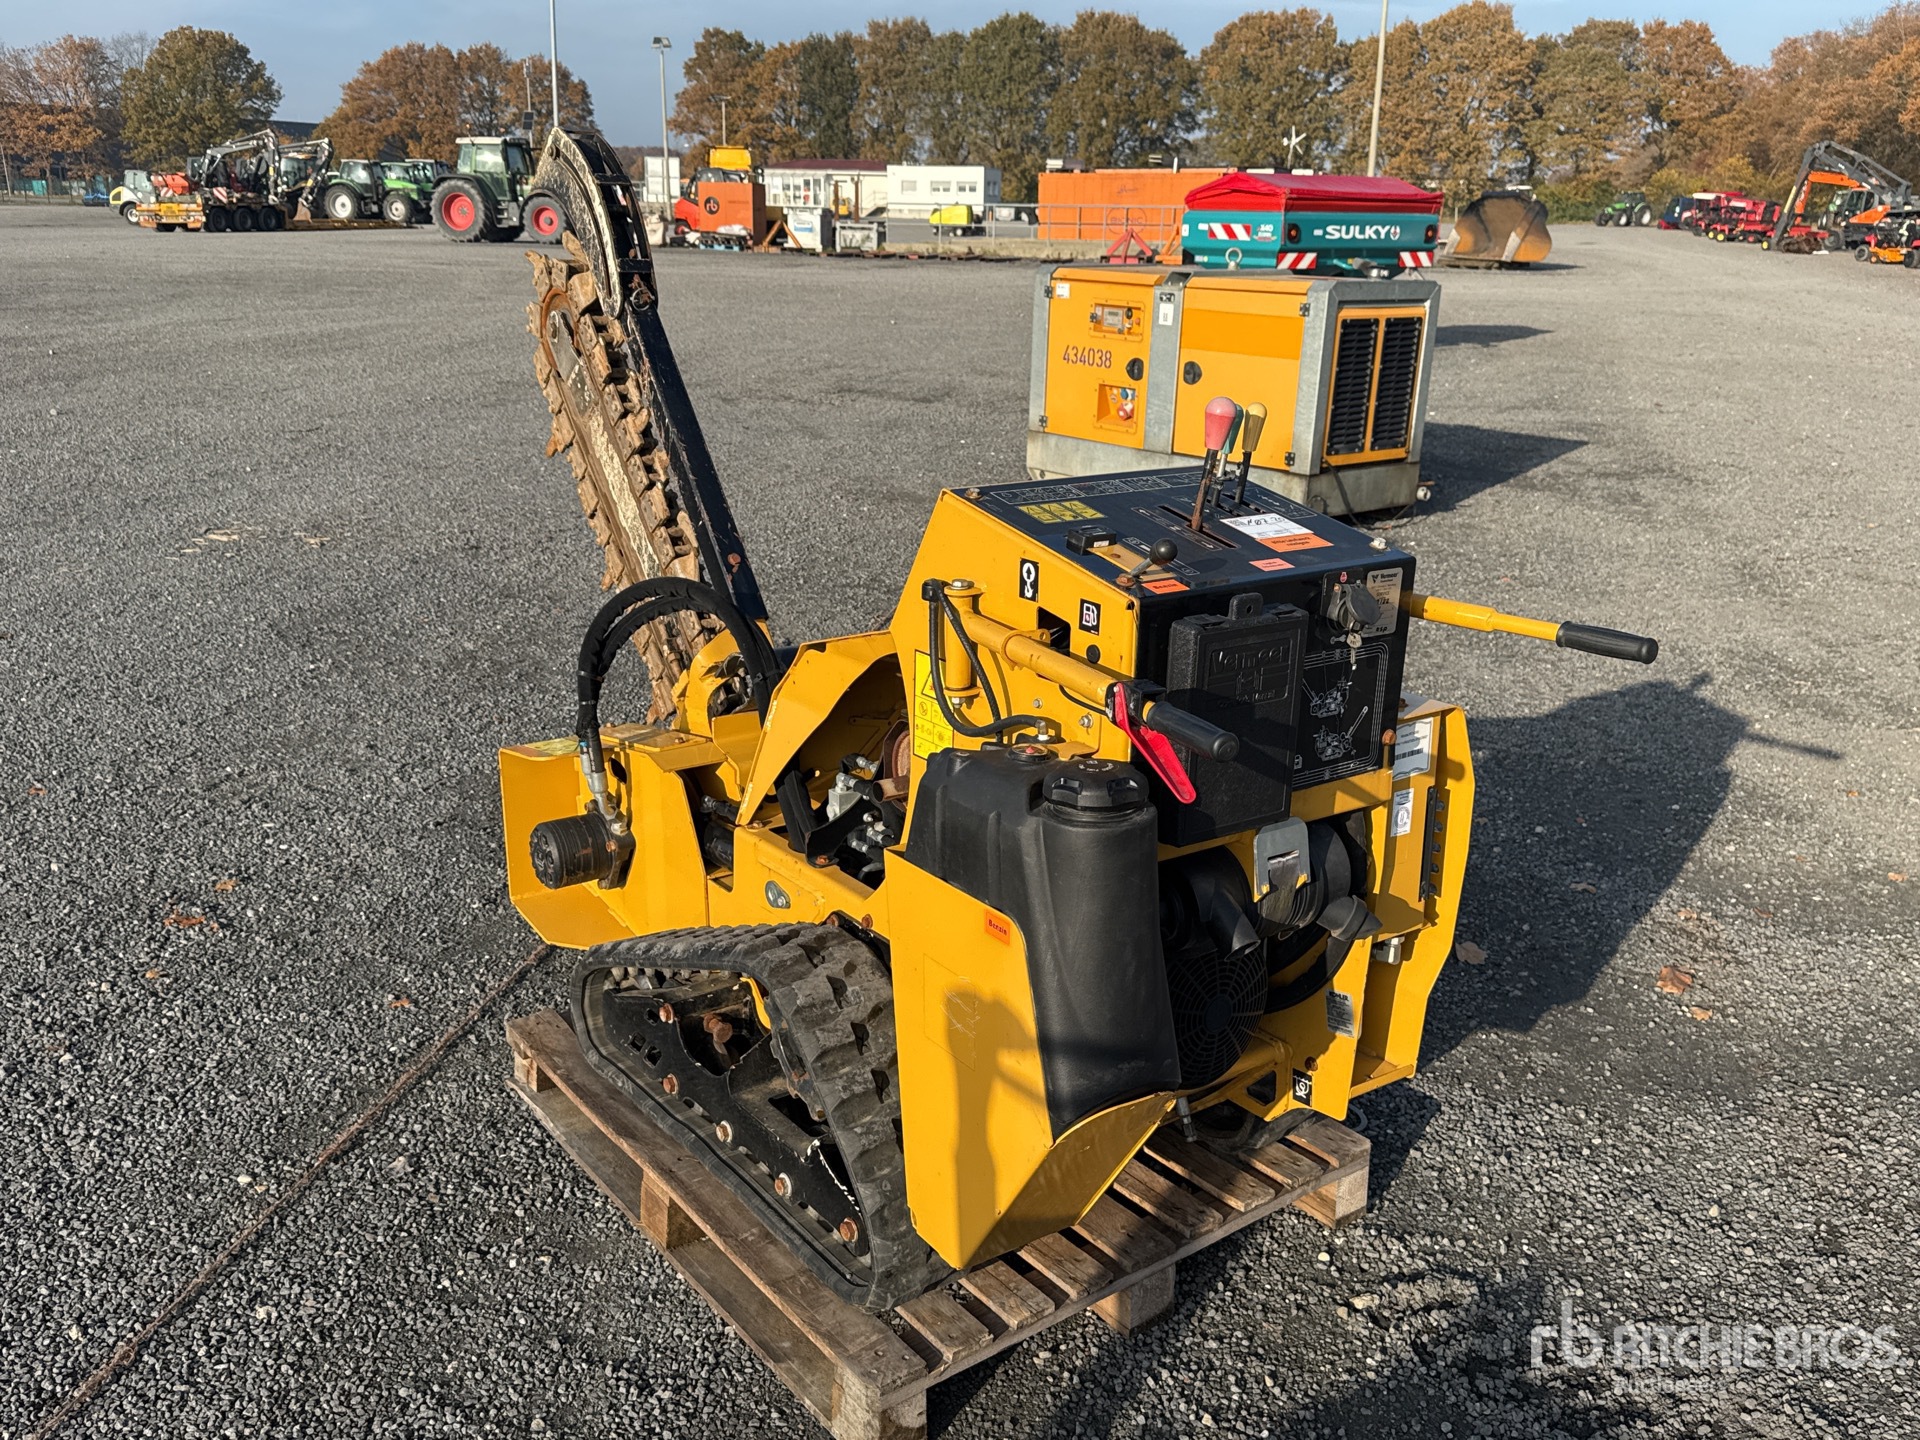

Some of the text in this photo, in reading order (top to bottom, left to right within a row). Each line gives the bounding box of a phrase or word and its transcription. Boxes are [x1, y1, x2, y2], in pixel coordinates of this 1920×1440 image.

[706, 199, 718, 212] rb
[1325, 225, 1390, 240] SULKY
[1062, 345, 1112, 369] 434038
[988, 919, 1008, 936] Benzin
